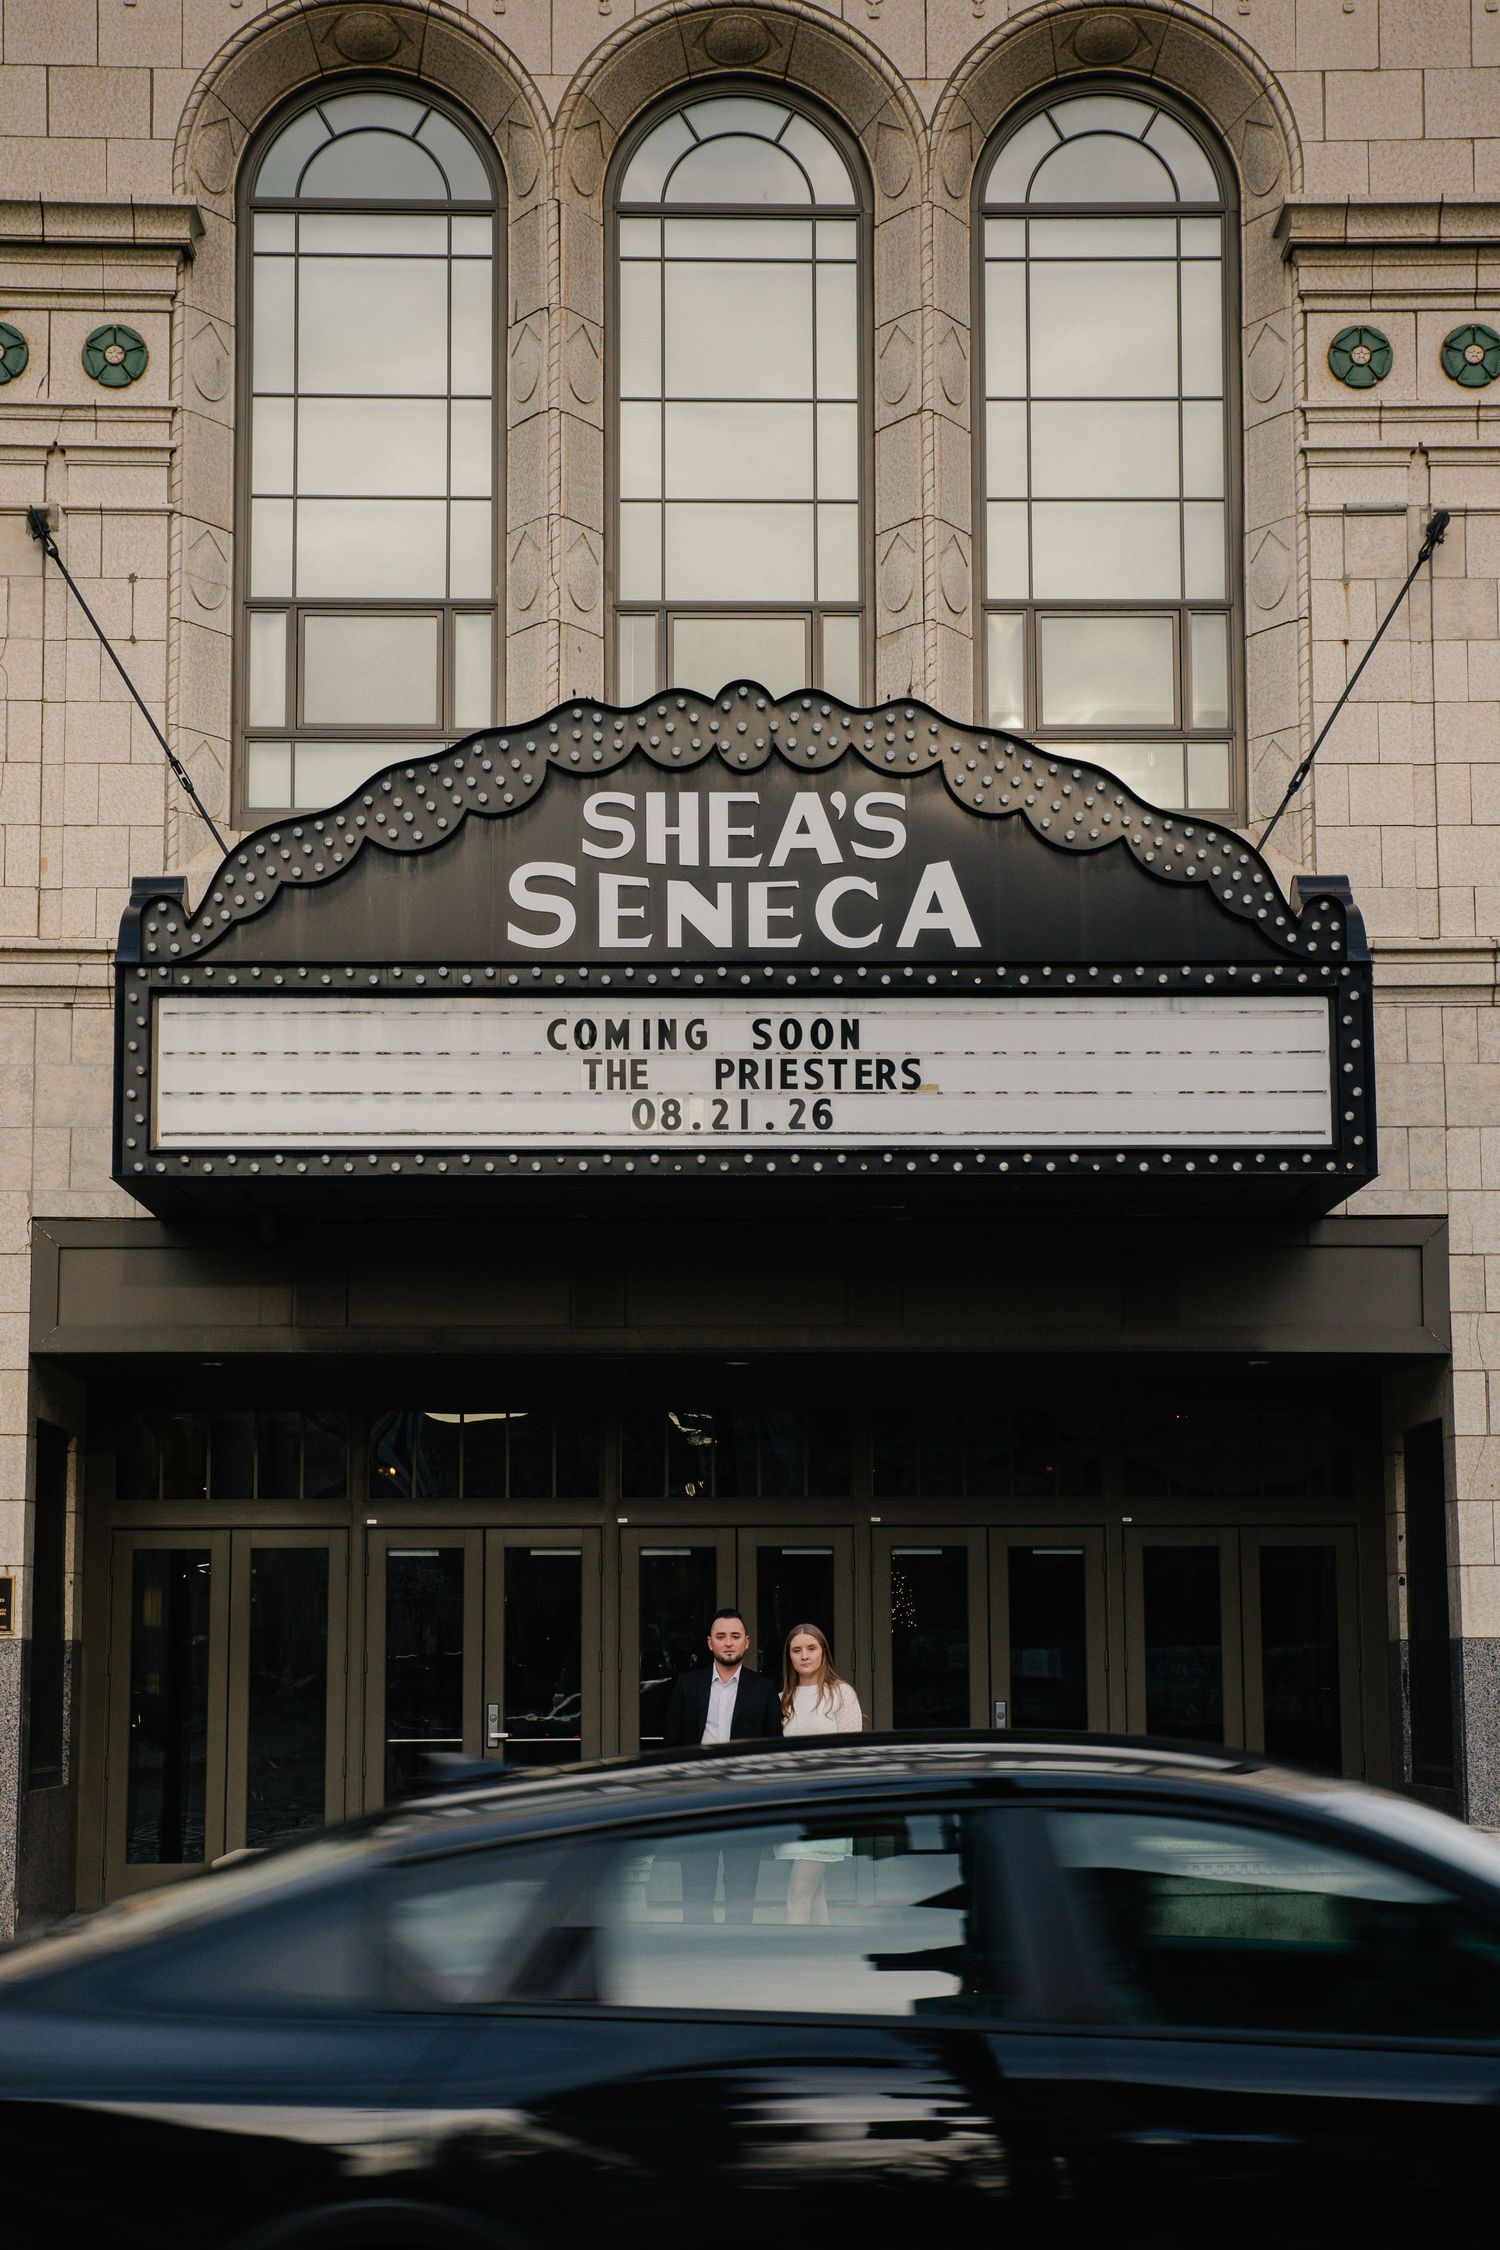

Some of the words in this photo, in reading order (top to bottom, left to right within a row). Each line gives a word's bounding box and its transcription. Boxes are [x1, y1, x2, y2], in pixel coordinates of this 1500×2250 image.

[582, 791, 907, 867] SHEA'S
[507, 860, 982, 949] SENECA
[547, 1018, 708, 1051] COMING
[752, 1018, 860, 1051] SOON
[583, 1058, 649, 1090] THE
[715, 1058, 921, 1090] PRIESTERS
[631, 1098, 833, 1131] 08.21.26
